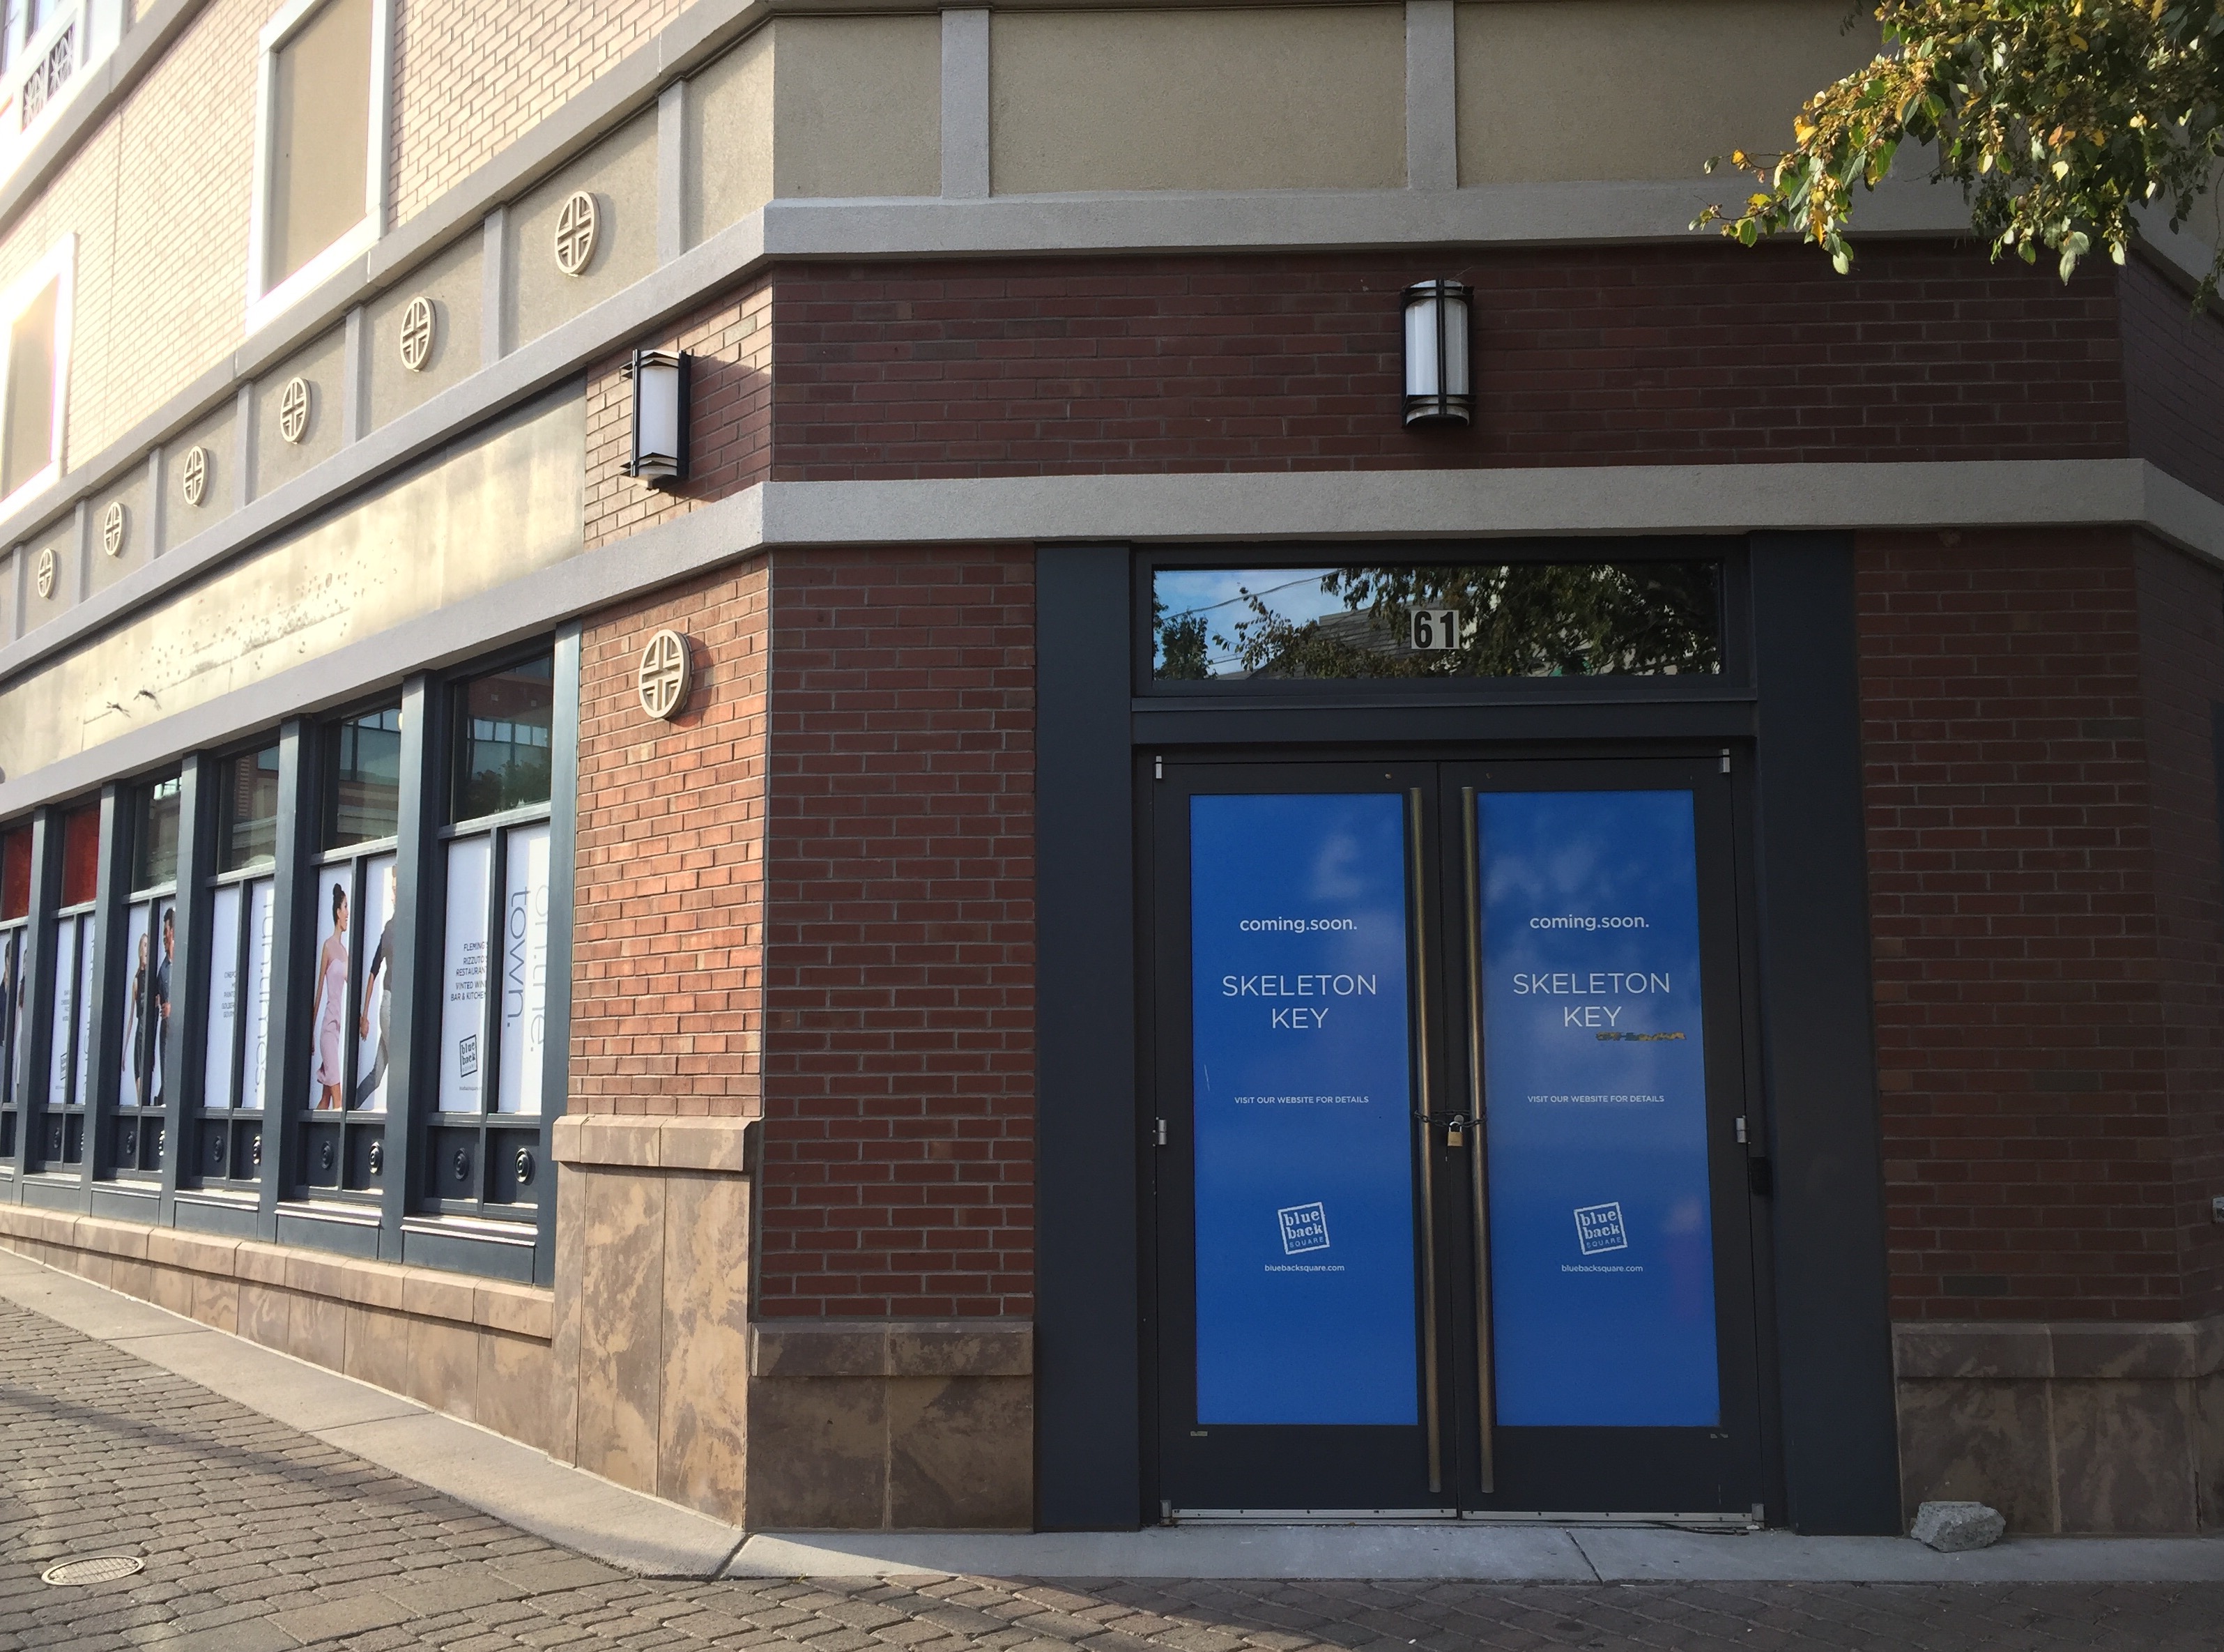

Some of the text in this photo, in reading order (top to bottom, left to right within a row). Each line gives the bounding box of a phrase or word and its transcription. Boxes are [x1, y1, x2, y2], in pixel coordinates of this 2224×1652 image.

[1413, 611, 1454, 648] 61
[1239, 916, 1358, 933] coming.soon.
[1529, 913, 1650, 931] coming.soon.
[463, 956, 487, 965] RIZZUTO
[507, 887, 530, 1027] town.
[456, 980, 486, 990] VINTED WIN
[1222, 974, 1376, 996] SKELETON
[1513, 972, 1670, 995] SKELETON
[451, 993, 461, 1002] BAR
[1271, 1008, 1329, 1029] KEY
[1563, 1006, 1623, 1027] KEY
[461, 1041, 475, 1055] blue
[461, 1053, 476, 1065] back
[1283, 1211, 1320, 1226] blue
[1580, 1211, 1616, 1226] blue
[1286, 1223, 1323, 1239] back
[1583, 1223, 1620, 1239] back
[1289, 1237, 1324, 1248] SQUARE
[1586, 1237, 1622, 1248] SQUARE
[1264, 1264, 1345, 1273] bluebacksquare.com
[1561, 1264, 1643, 1274] bluebacksquare.com
